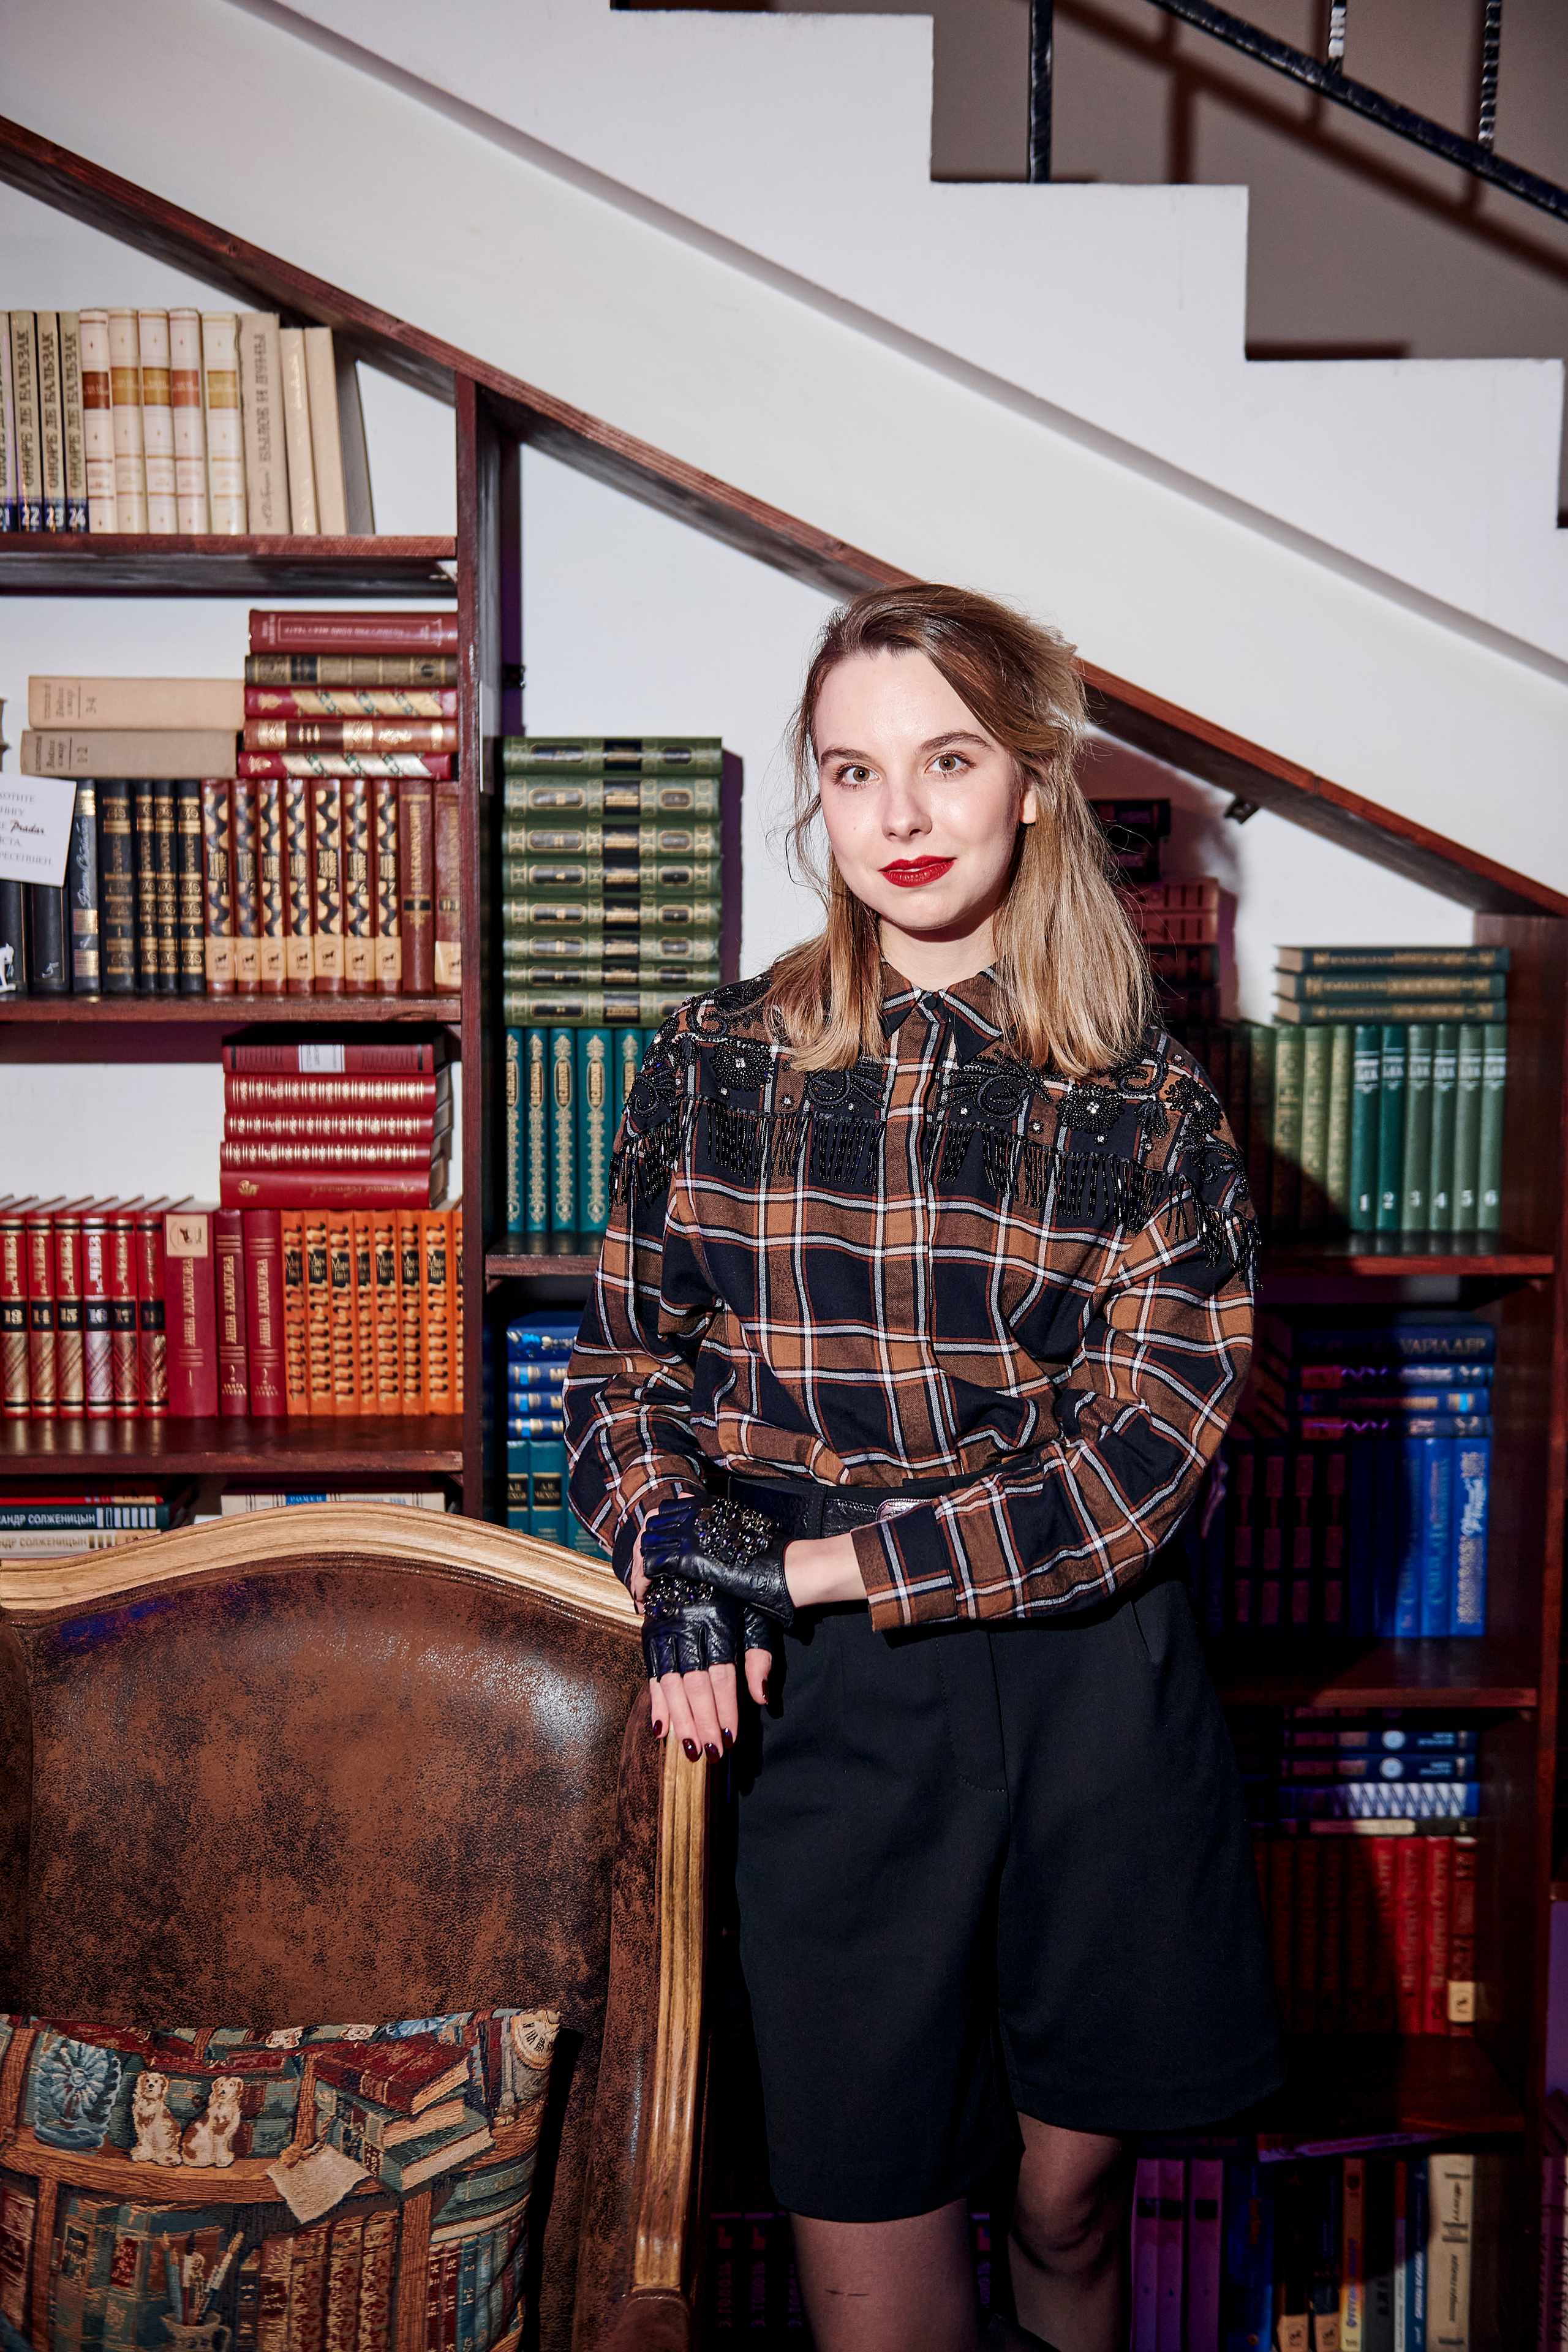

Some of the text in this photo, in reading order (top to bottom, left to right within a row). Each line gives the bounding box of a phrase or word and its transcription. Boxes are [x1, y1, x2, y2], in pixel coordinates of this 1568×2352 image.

[17, 330, 31, 402] БАЛЬЗАК
[42, 332, 56, 404] БАЛЬЗАК
[64, 332, 78, 405] БАЛЬЗАК
[22, 505, 40, 527] 22
[45, 507, 64, 527] 23
[68, 507, 86, 527] 24
[221, 881, 227, 894] 1
[249, 882, 257, 894] 2
[330, 879, 337, 892] 5
[358, 882, 367, 894] 6
[388, 881, 396, 894] 7
[1359, 1194, 1368, 1212] 1
[1382, 1191, 1394, 1209] 2
[1410, 1189, 1420, 1207] 3
[1434, 1191, 1446, 1209] 4
[1460, 1189, 1472, 1208] 5
[182, 1257, 196, 1347] АННА АХМАТОВА
[222, 1255, 237, 1344] АННА АХМАТОВА
[256, 1258, 271, 1348] АННА АХМАТОВА
[3, 1308, 23, 1325] 13
[59, 1308, 78, 1324] 15
[88, 1308, 108, 1324] 16
[314, 1305, 323, 1321] 2
[338, 1309, 347, 1324] 3
[433, 1306, 444, 1321] 7
[28, 1513, 96, 1526] СОЛЖЕНИЦЫН
[20, 1536, 87, 1547] СОЛЖЕНИЦЫН
